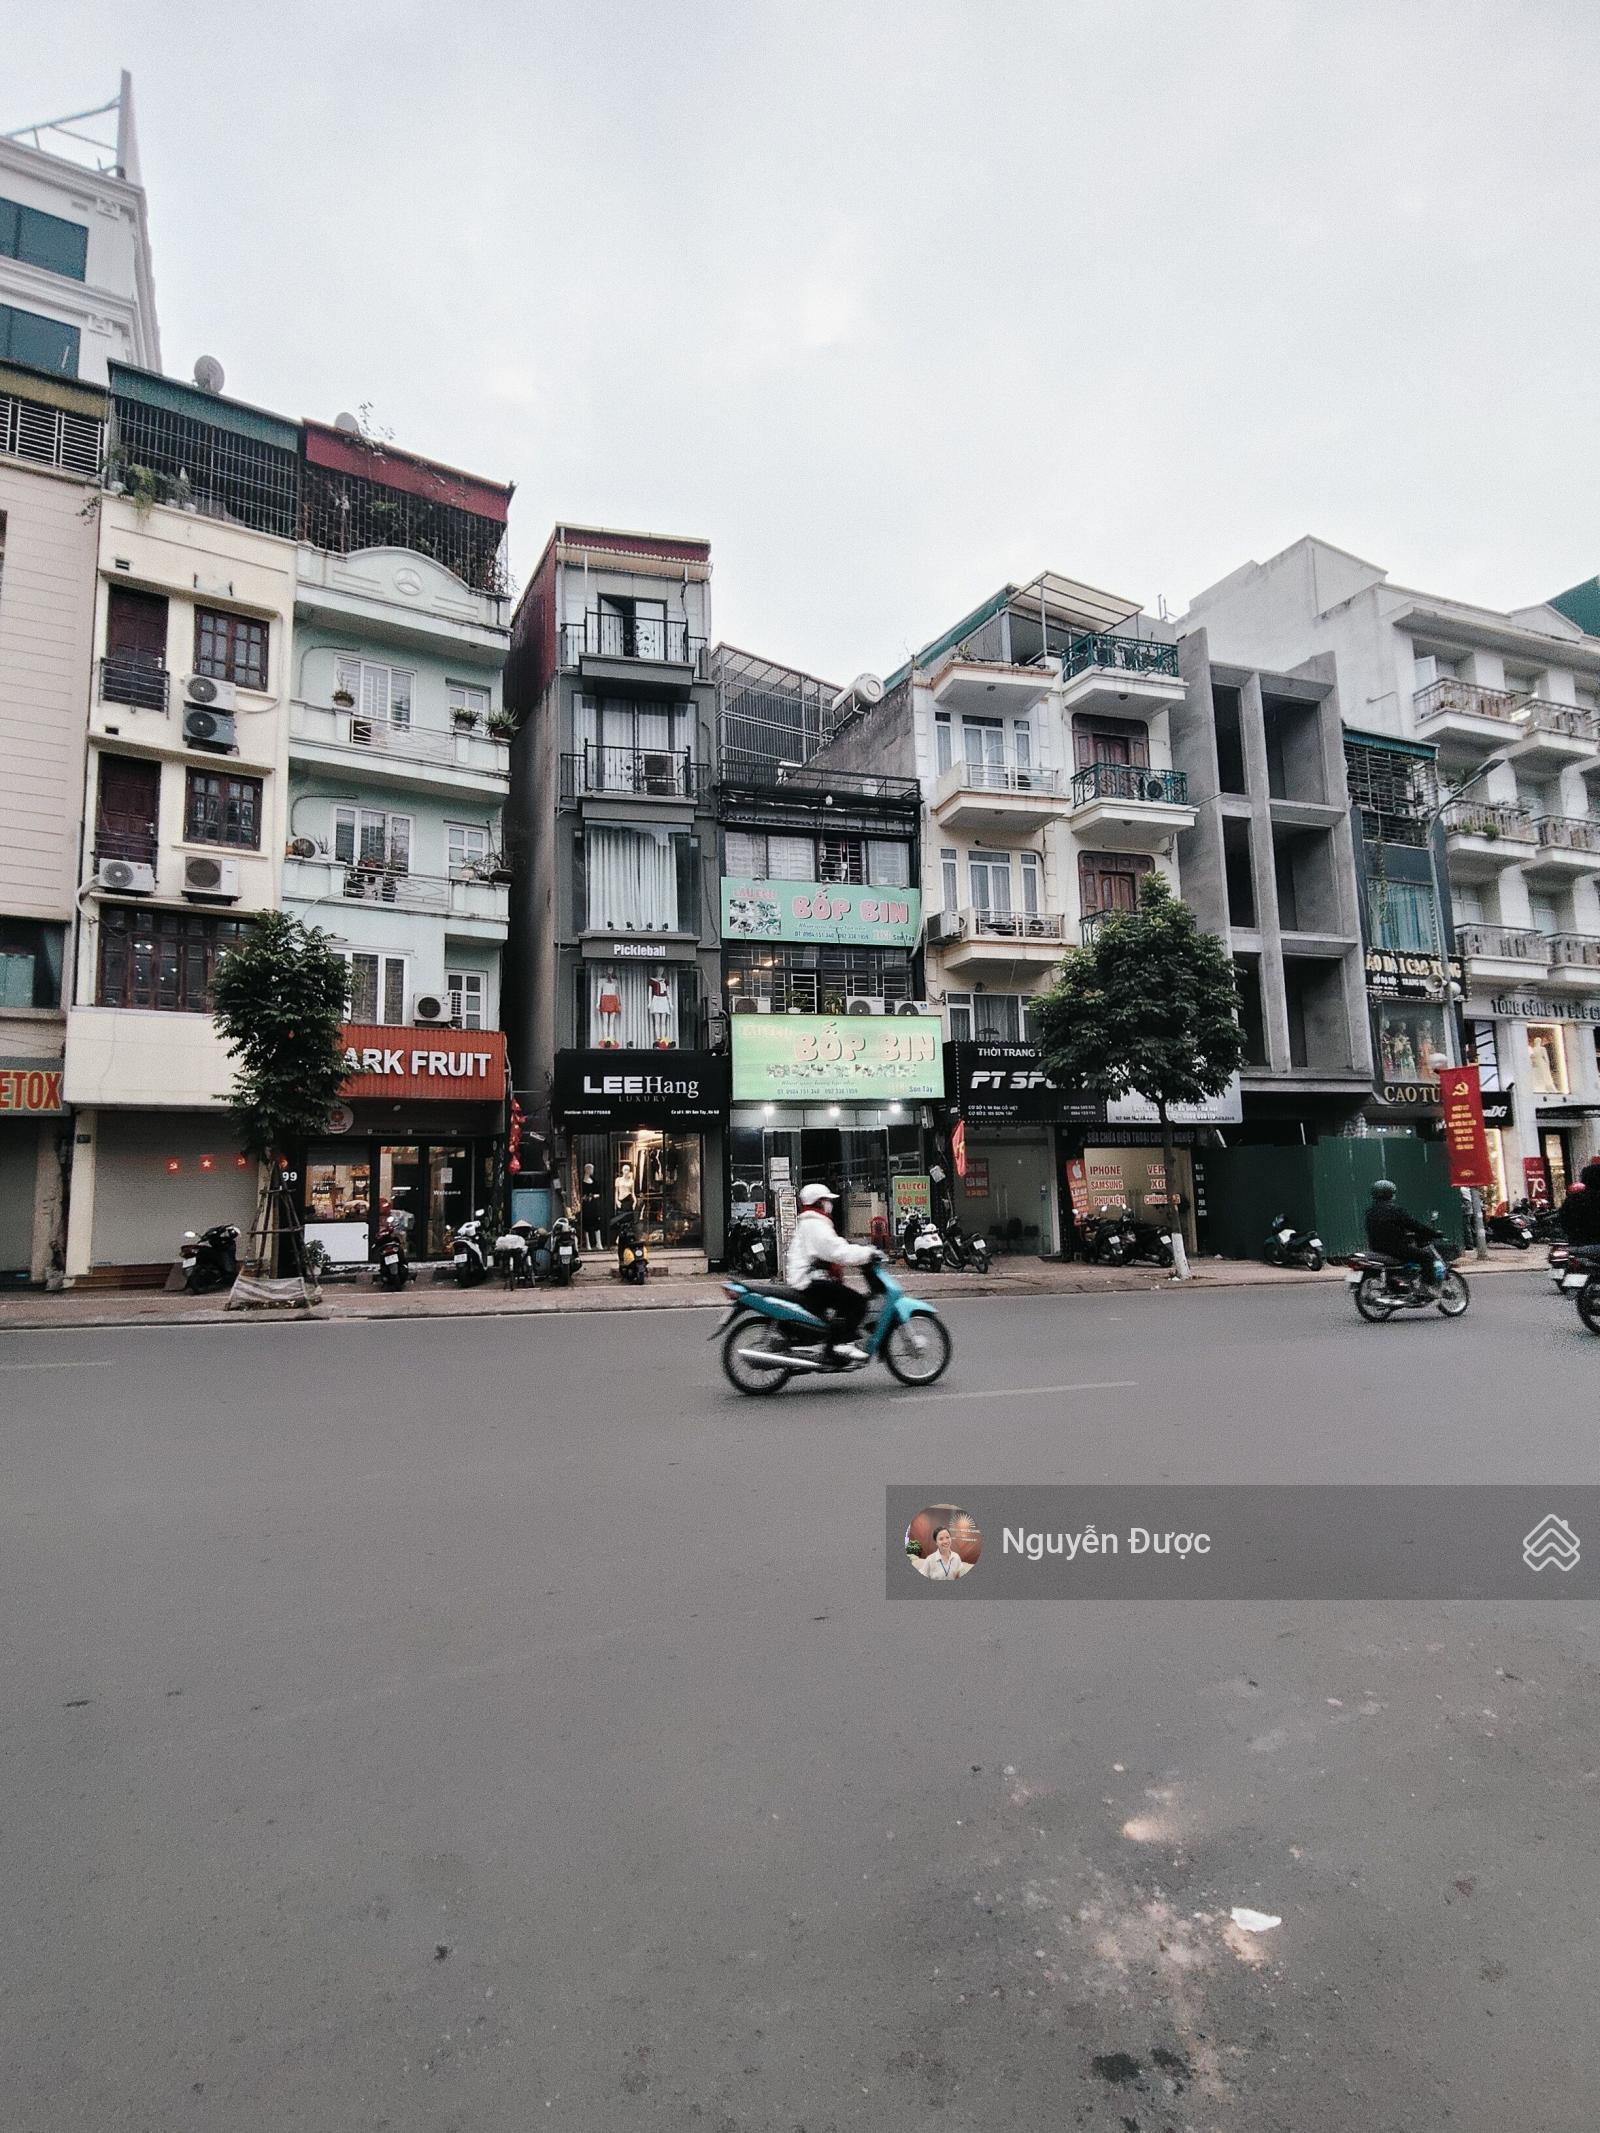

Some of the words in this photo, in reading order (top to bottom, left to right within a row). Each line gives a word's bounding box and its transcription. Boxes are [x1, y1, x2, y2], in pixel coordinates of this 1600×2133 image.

[862, 900, 909, 924] BIN
[613, 943, 666, 957] Pickleball
[879, 1033, 935, 1061] BIN
[978, 1046, 1001, 1056] THỜI
[1003, 1048, 1035, 1057] TRANG
[411, 1050, 491, 1077] FRUIT
[970, 1071, 1006, 1089] PT
[618, 1095, 669, 1103] LUXURY
[1384, 1086, 1417, 1102] CAO
[282, 1171, 298, 1182] 99
[1090, 1165, 1121, 1175] IPHONE
[1091, 1181, 1123, 1190] SAMSUNG
